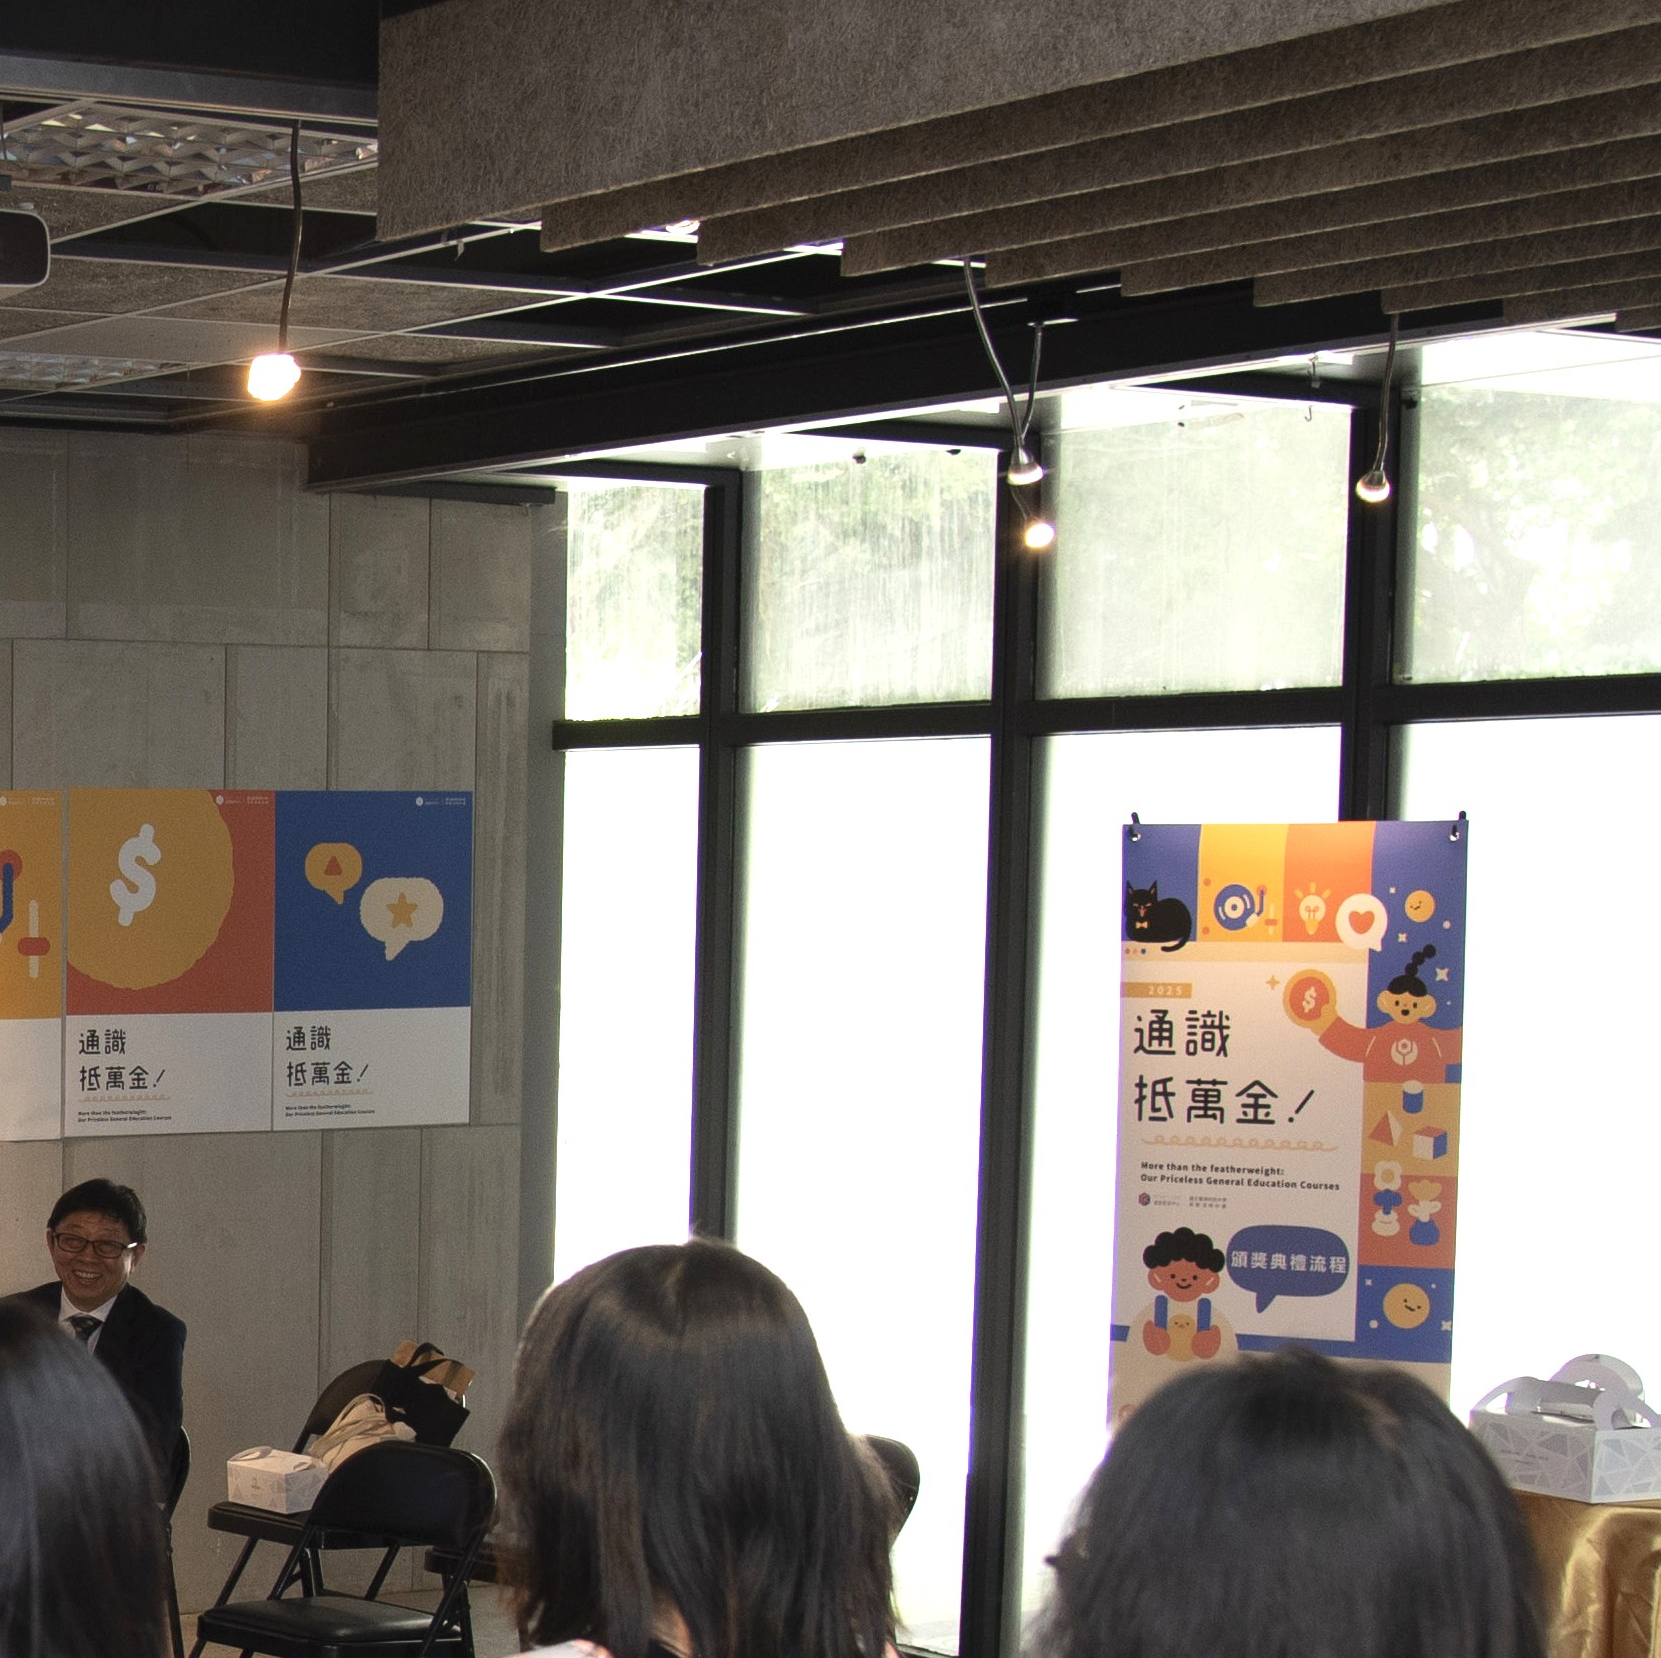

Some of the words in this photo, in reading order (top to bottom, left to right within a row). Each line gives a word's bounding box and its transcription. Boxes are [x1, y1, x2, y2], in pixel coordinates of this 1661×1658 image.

[1148, 985, 1183, 996] 2025
[79, 1029, 126, 1055] 通識
[286, 1025, 331, 1050] 通識
[1133, 1009, 1230, 1057] 通識
[1141, 1161, 1164, 1170] More
[1166, 1163, 1188, 1172] than
[1191, 1164, 1207, 1172] the
[1140, 1173, 1158, 1182] Our
[1160, 1174, 1203, 1184] Priceless
[1206, 1176, 1244, 1187] General
[1247, 1178, 1297, 1189] Education
[1300, 1181, 1340, 1191] Courses
[1230, 1251, 1347, 1274] 頒獎典禮流程
